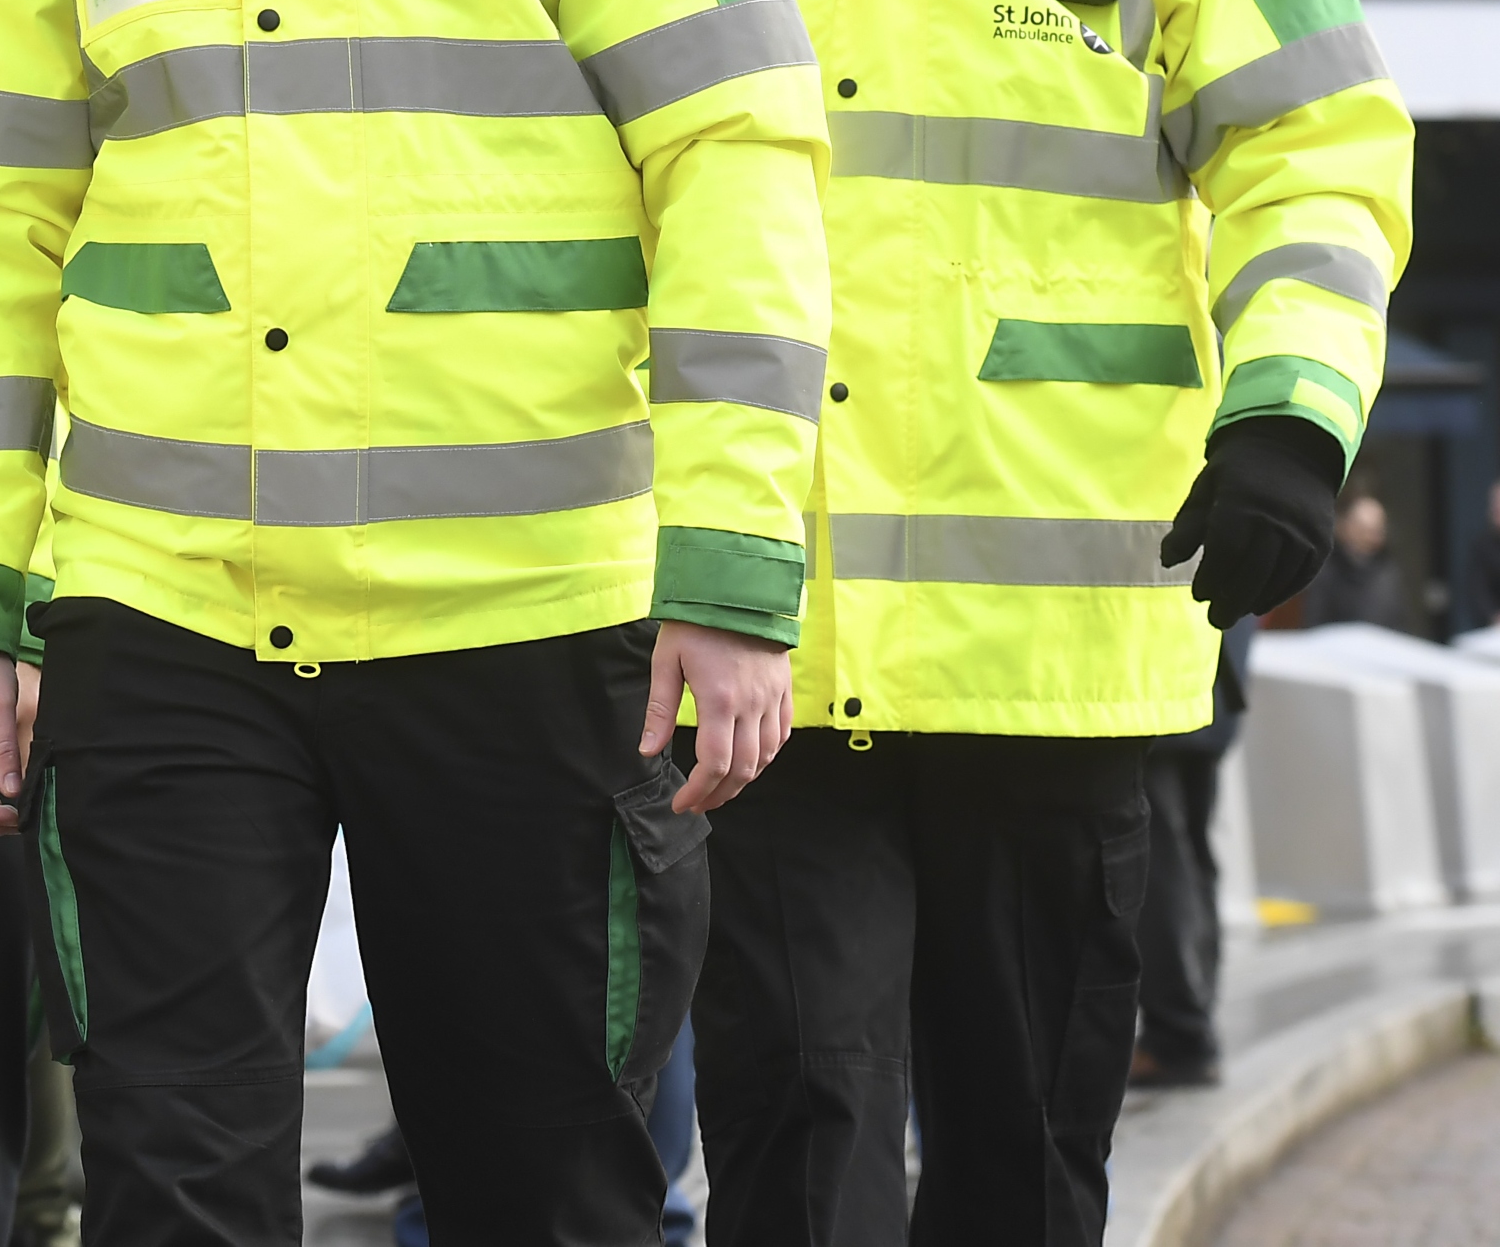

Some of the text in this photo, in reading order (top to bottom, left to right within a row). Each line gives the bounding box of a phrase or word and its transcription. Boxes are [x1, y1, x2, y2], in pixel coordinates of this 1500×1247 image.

[993, 4, 1073, 29] St John
[993, 25, 1074, 45] Ambulance
